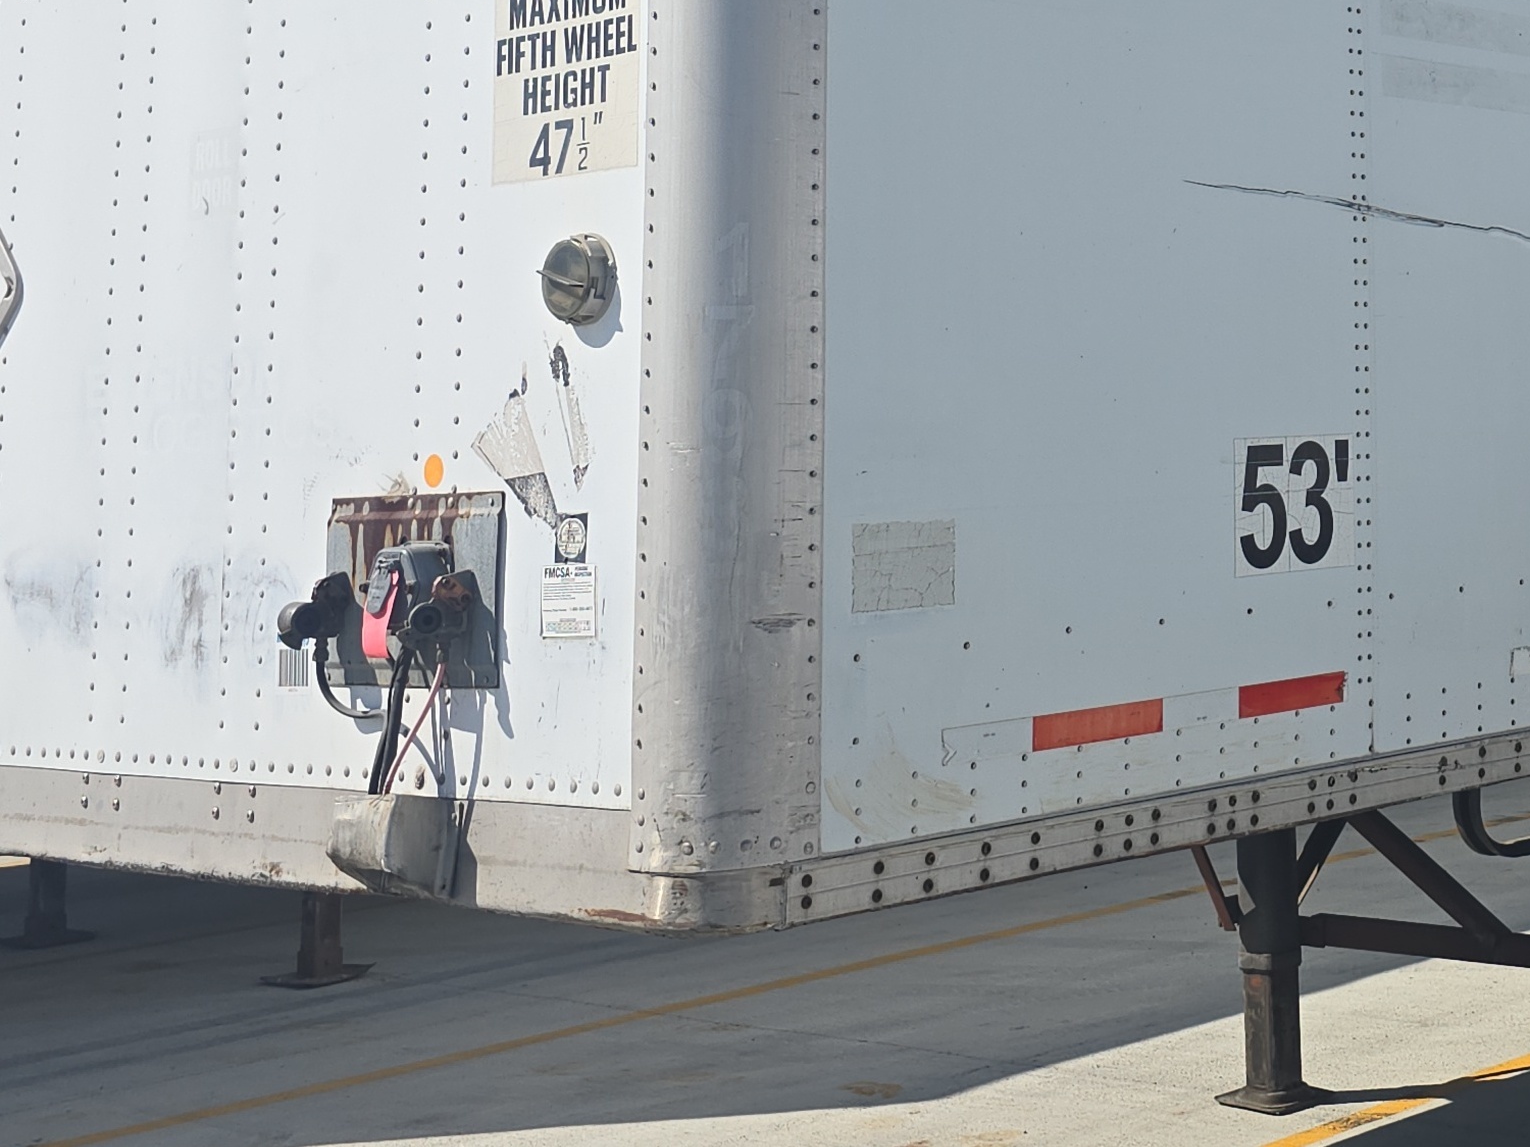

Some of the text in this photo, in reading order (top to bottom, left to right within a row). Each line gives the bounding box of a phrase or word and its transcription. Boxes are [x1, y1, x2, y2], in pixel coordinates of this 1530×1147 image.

[496, 14, 638, 77] FIFTH WHEEL
[522, 63, 611, 116] HEIGHT
[1240, 439, 1349, 569] 53'
